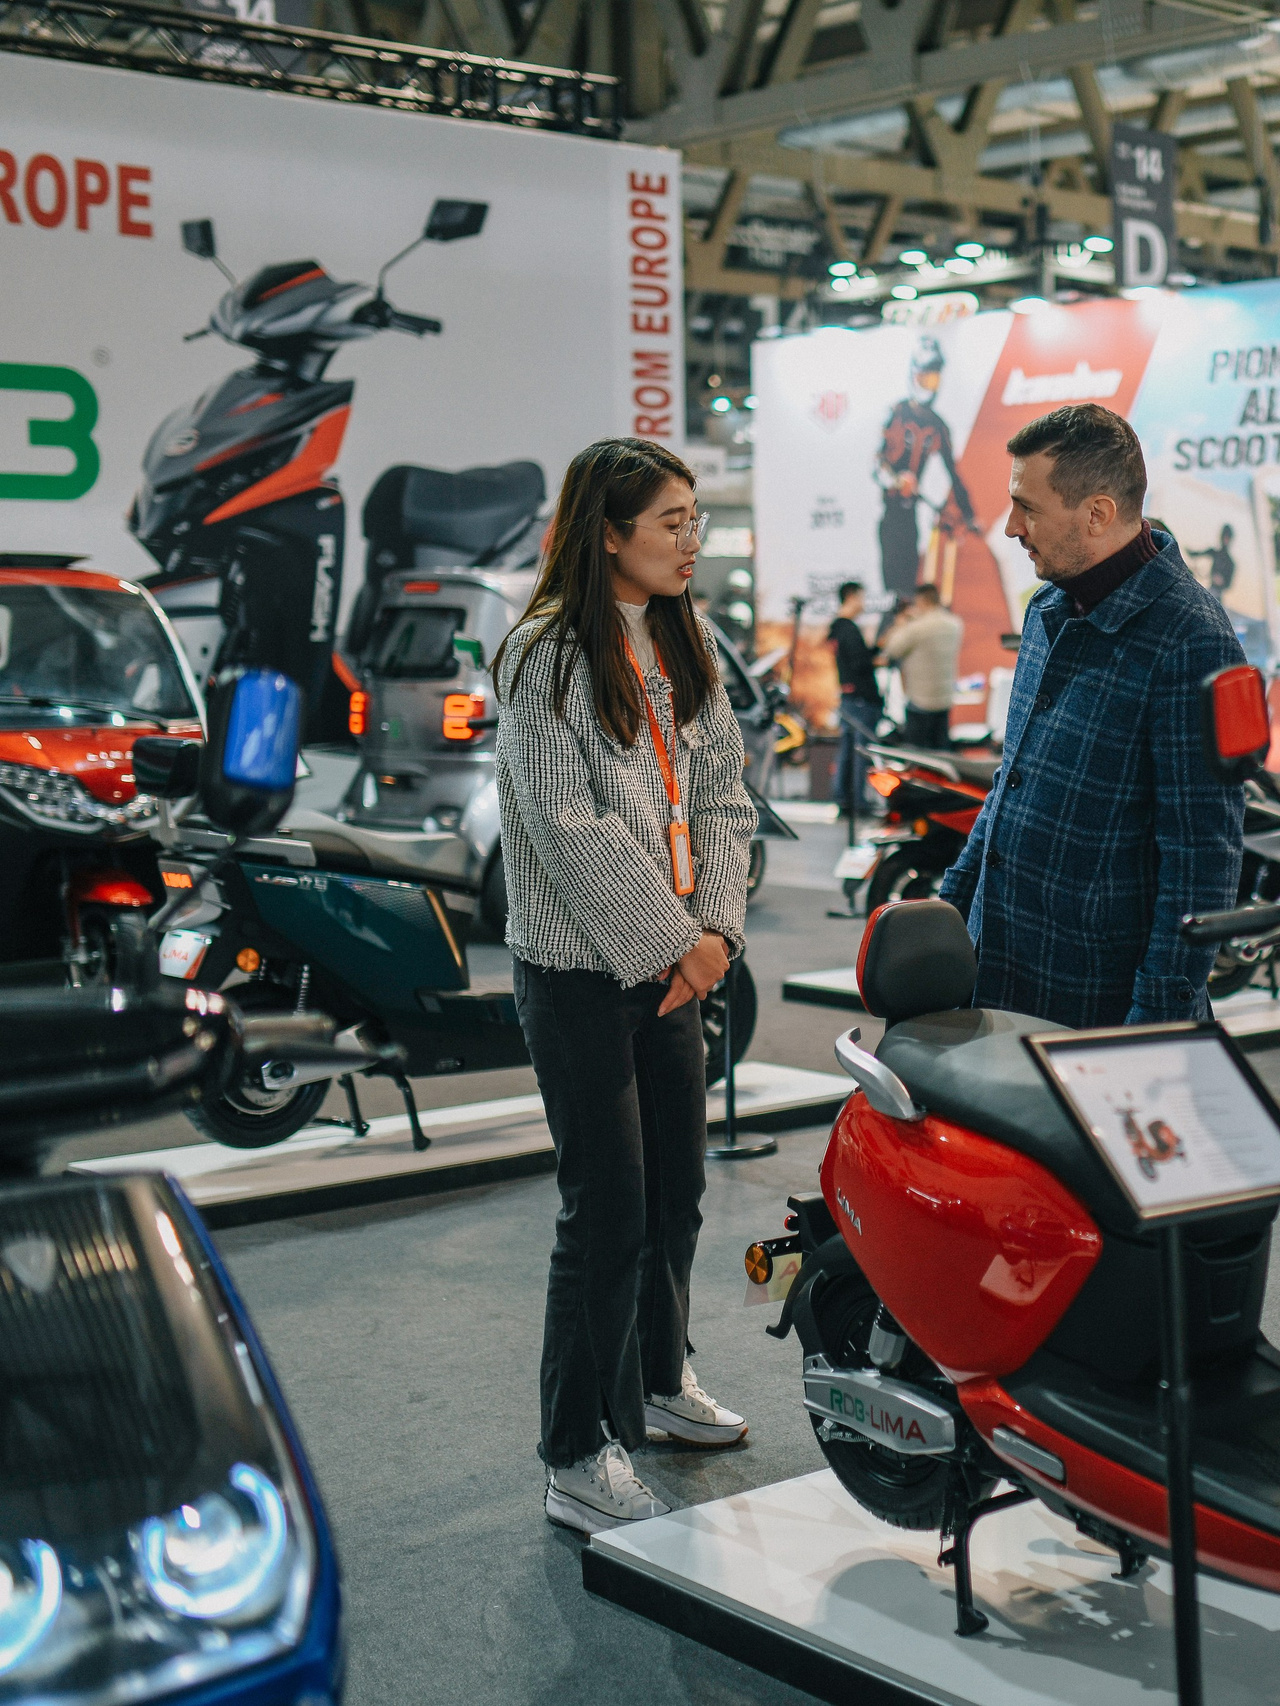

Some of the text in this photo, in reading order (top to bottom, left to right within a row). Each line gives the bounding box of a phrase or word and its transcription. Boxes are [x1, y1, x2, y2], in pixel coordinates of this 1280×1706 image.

[629, 171, 670, 335] EUROPE
[1122, 217, 1169, 288] D
[836, 1187, 862, 1237] LIMA
